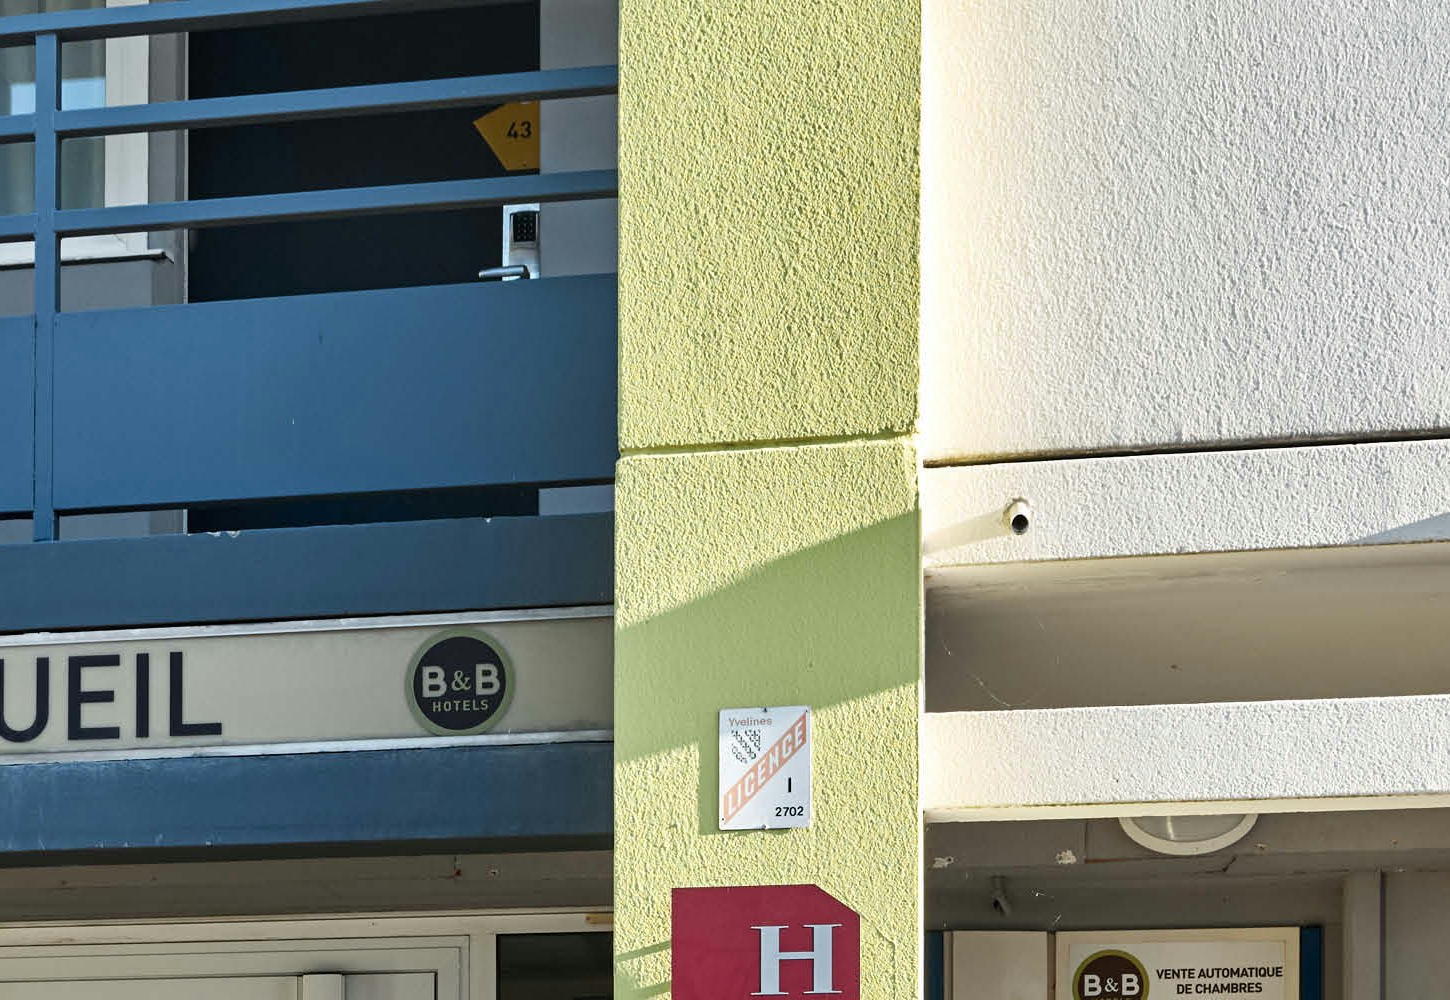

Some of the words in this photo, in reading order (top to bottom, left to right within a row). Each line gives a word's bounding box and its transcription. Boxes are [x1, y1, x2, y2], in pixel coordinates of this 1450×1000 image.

[507, 121, 532, 138] 43
[422, 663, 500, 698] B&B
[432, 700, 488, 712] HOTELS
[729, 717, 772, 727] Yvelines
[727, 719, 805, 815] LICENCE
[775, 805, 804, 817] 2702
[750, 923, 843, 995] H
[1156, 968, 1195, 980] VENTE
[1198, 966, 1283, 979] AUTOMATIQUE
[1084, 973, 1140, 997] B&B
[1176, 984, 1193, 995] DE
[1195, 982, 1263, 994] CHAMBRES
